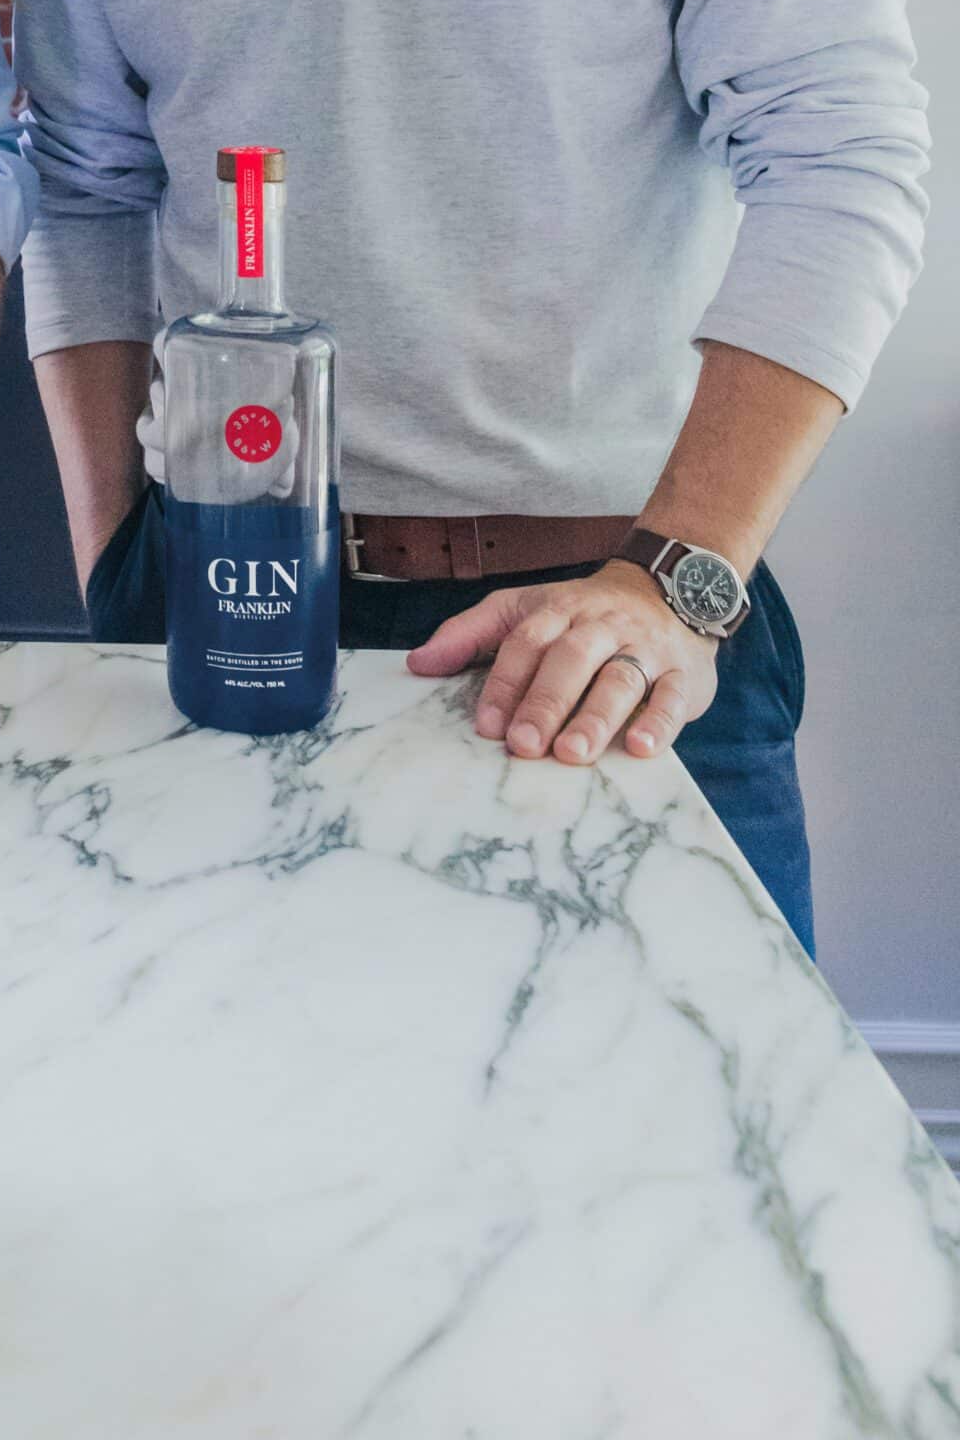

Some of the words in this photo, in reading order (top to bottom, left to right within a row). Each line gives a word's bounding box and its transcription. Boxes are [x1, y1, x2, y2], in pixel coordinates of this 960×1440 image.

[245, 208, 255, 271] FRANKLIN
[207, 558, 300, 596] GIN
[218, 599, 291, 615] FRANKLIN
[227, 658, 259, 666] DISTILLED
[284, 656, 304, 665] SOUTH
